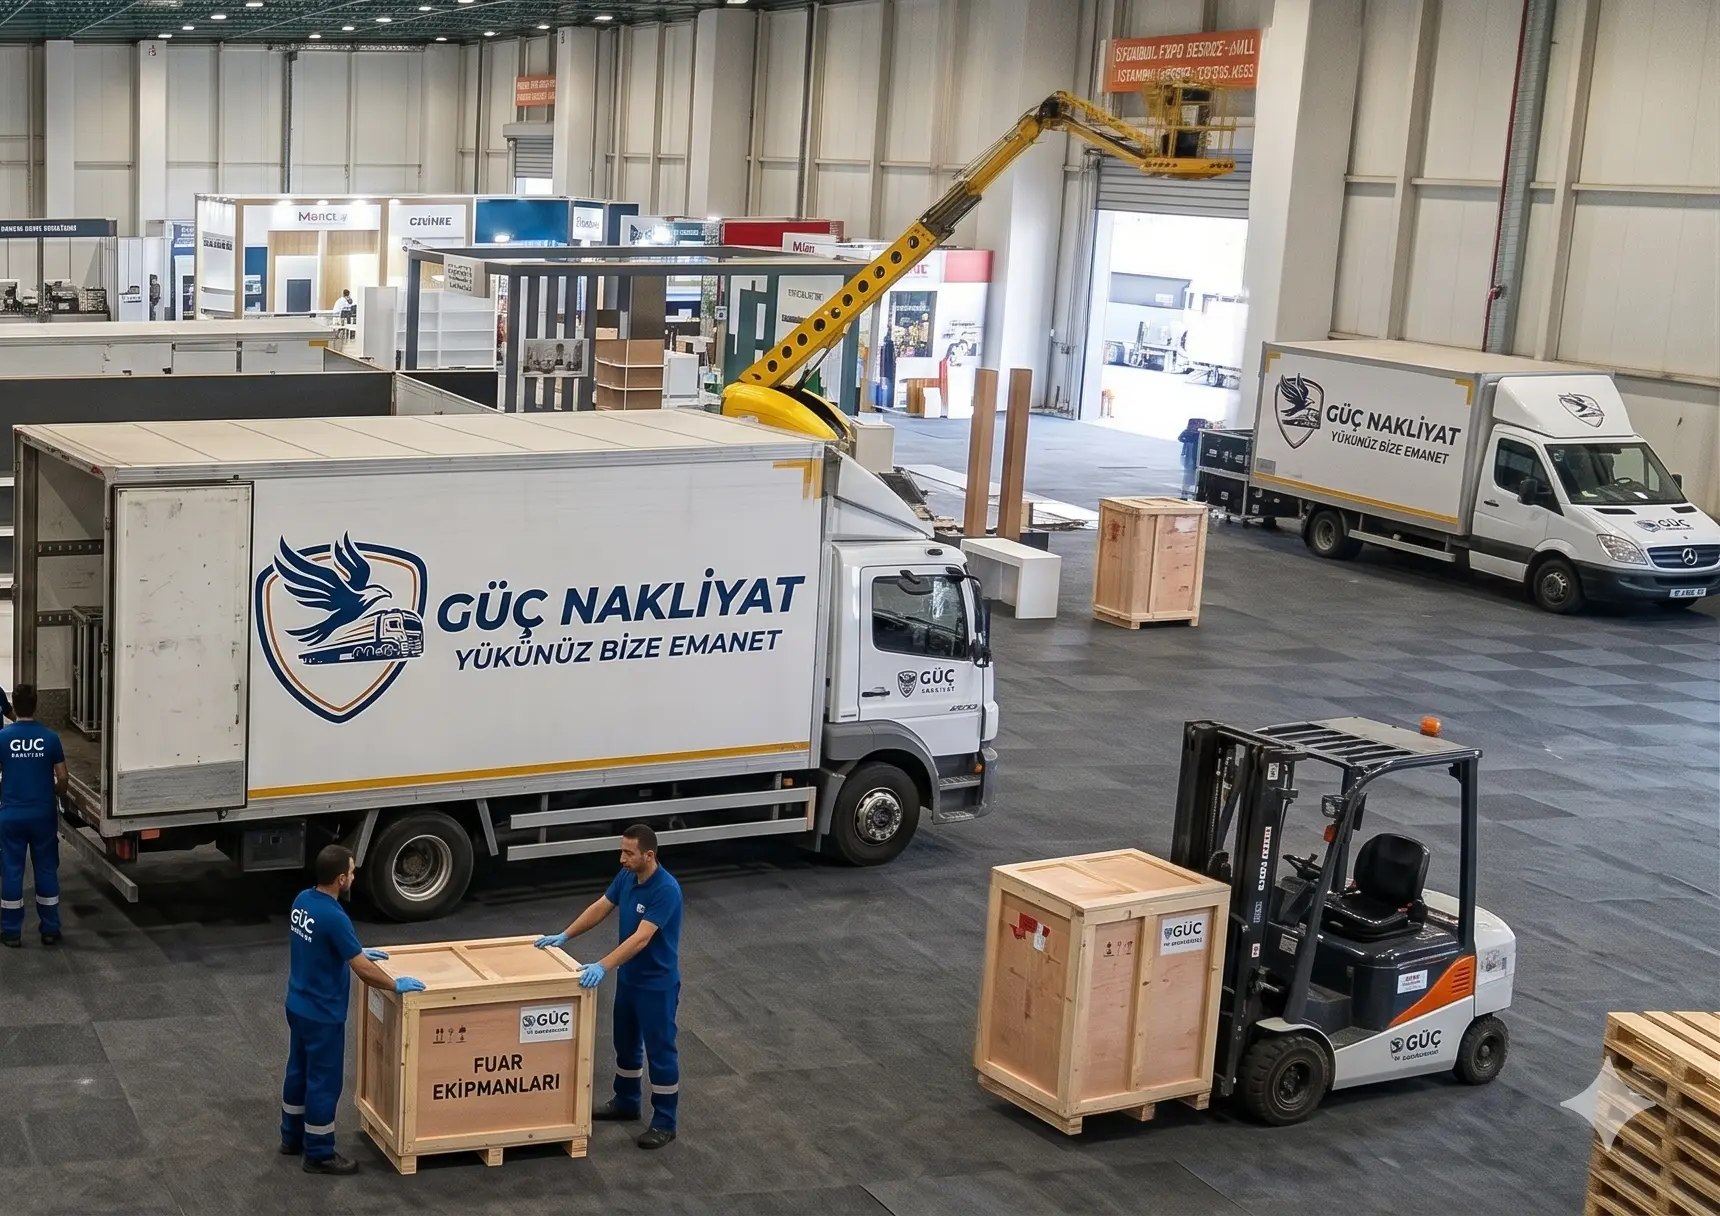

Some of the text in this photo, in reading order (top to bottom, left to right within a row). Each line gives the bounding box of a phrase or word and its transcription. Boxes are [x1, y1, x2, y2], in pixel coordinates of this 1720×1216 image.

[1326, 402, 1462, 446] GÜÇ NAKLİYAT
[1378, 439, 1403, 456] BİZE
[1404, 446, 1450, 465] EMANET
[436, 567, 806, 639] GÜÇ NAKLİYAT
[455, 629, 783, 671] YÜKÜNÜZ BİZE EMANET
[920, 667, 955, 686] GÜÇ
[10, 738, 45, 751] GUC
[1406, 1029, 1442, 1051] GÜÇ
[474, 1054, 523, 1074] FUAR
[433, 1073, 560, 1100] EKİPMANLARI
